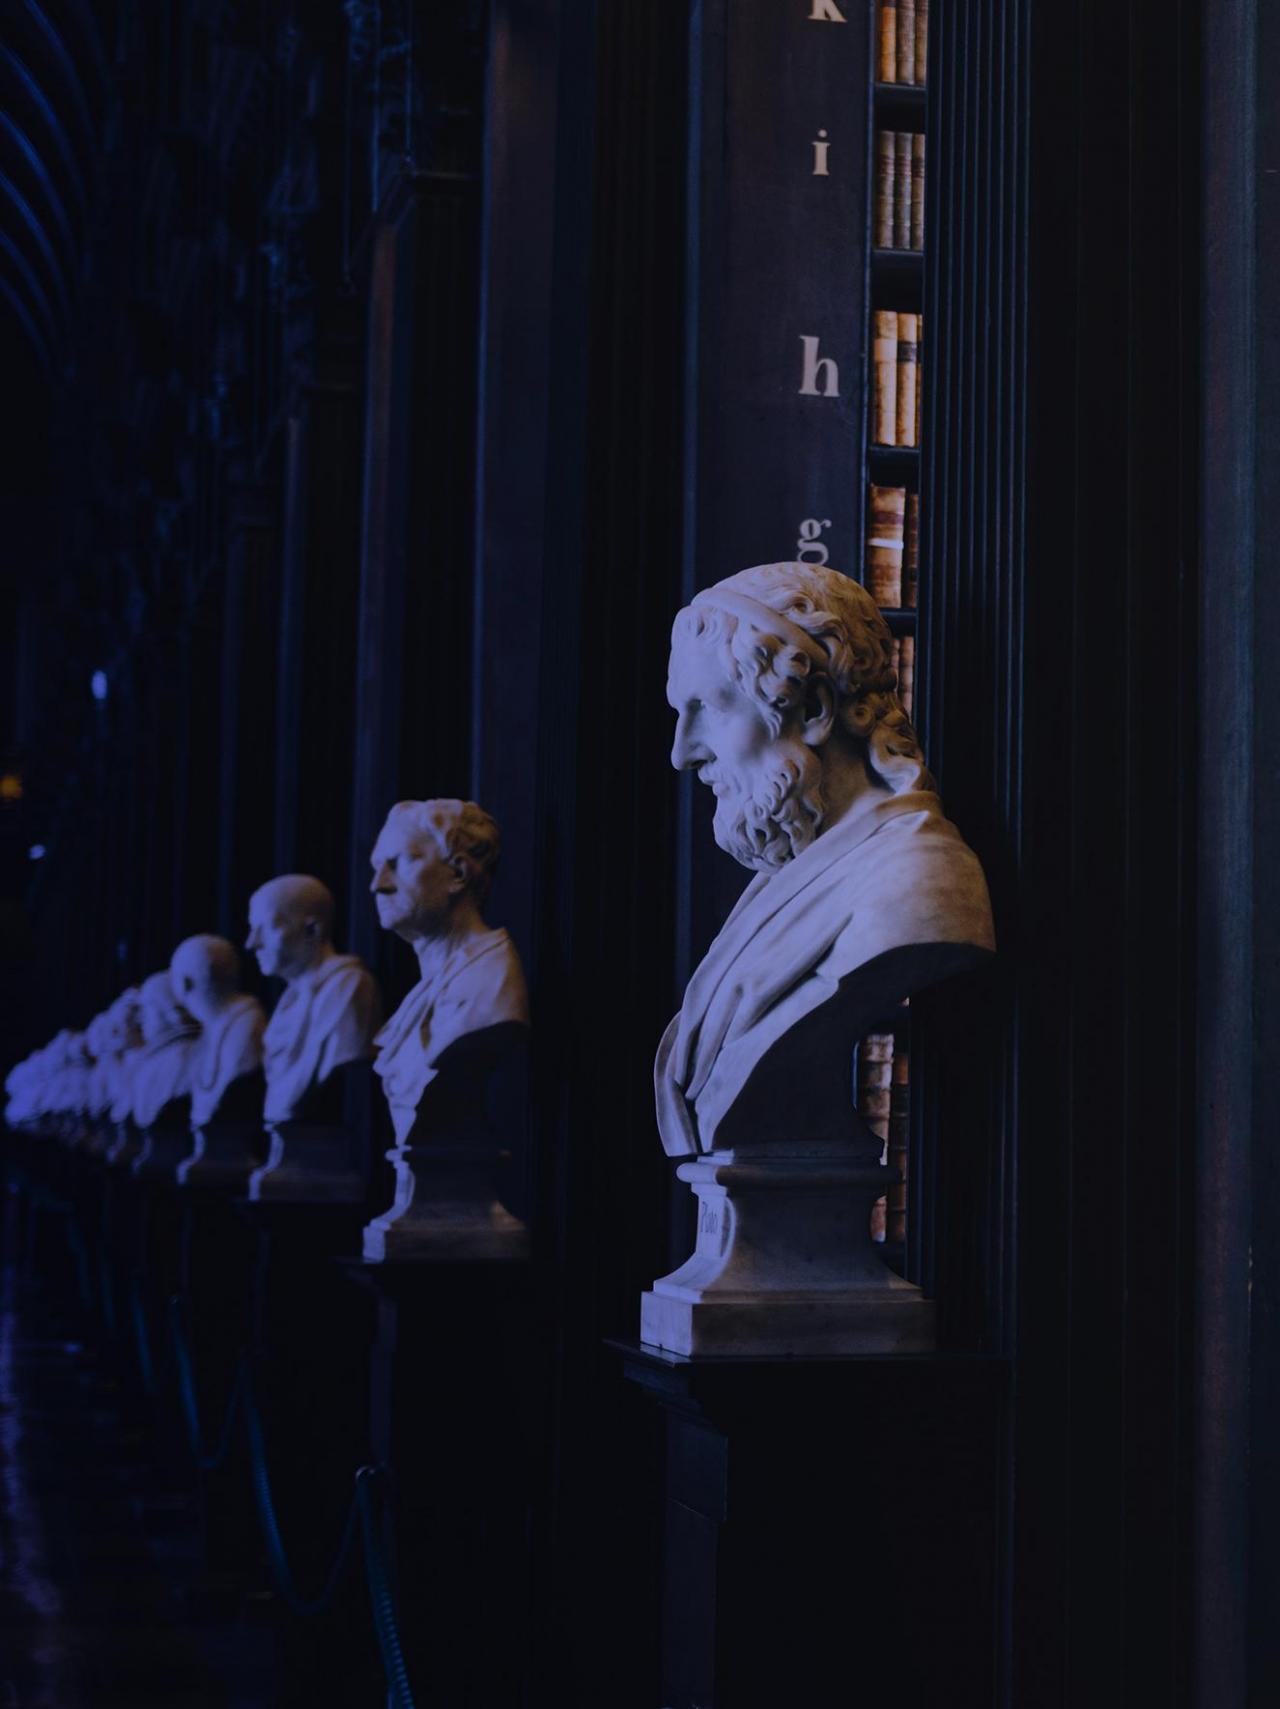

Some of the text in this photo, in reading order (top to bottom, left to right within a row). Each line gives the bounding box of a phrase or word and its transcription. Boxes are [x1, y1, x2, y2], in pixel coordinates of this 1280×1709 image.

[811, 129, 831, 176] i
[798, 335, 840, 397] h
[796, 518, 832, 566] g
